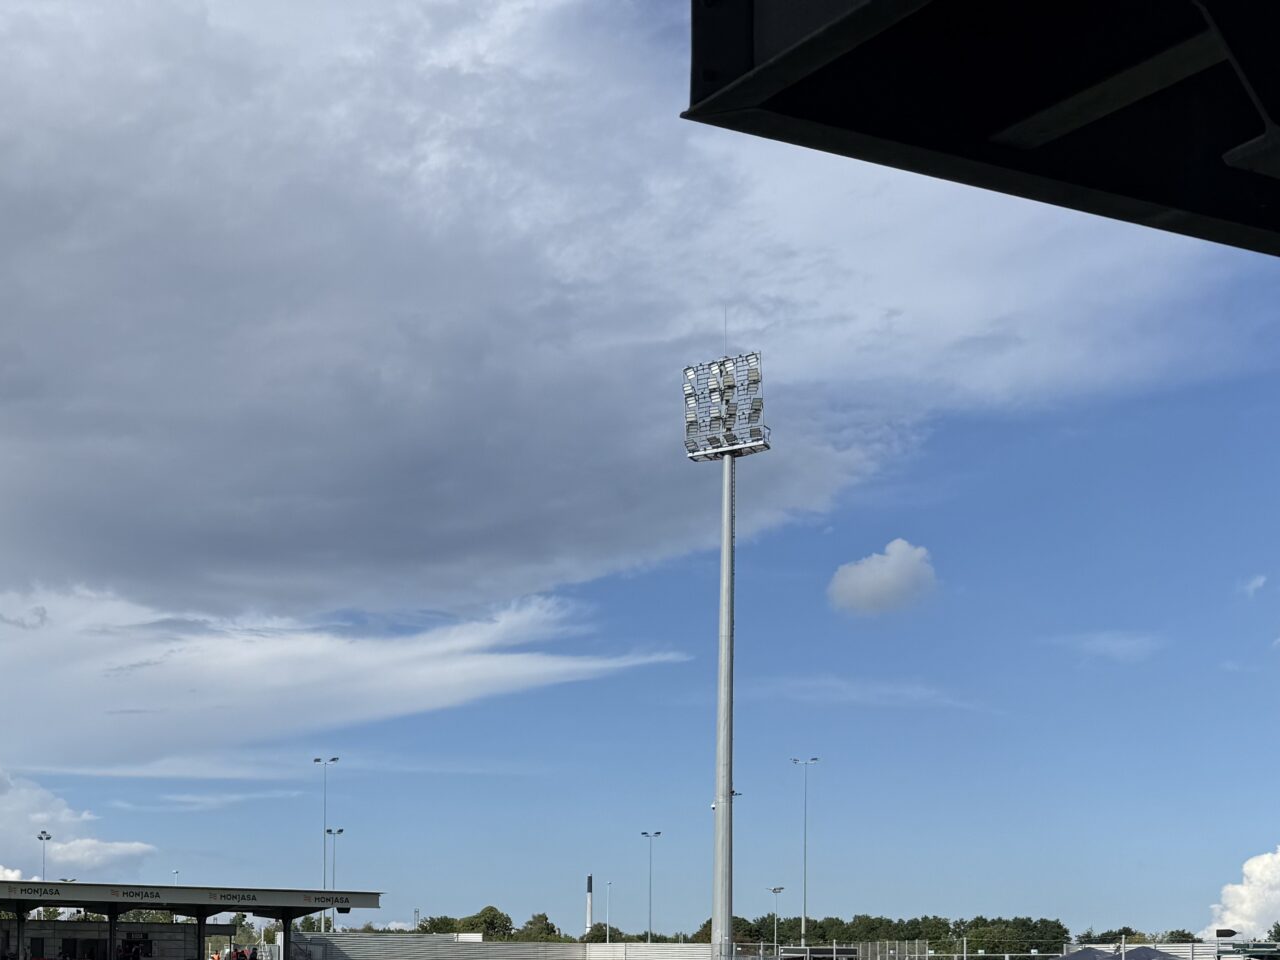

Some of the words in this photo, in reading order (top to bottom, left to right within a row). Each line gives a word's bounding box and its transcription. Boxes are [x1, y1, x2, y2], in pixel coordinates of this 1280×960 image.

[20, 887, 60, 897] MONJASA
[122, 891, 161, 900] MONJASA
[220, 894, 257, 903] MONJASA
[314, 896, 350, 905] MONJASA
